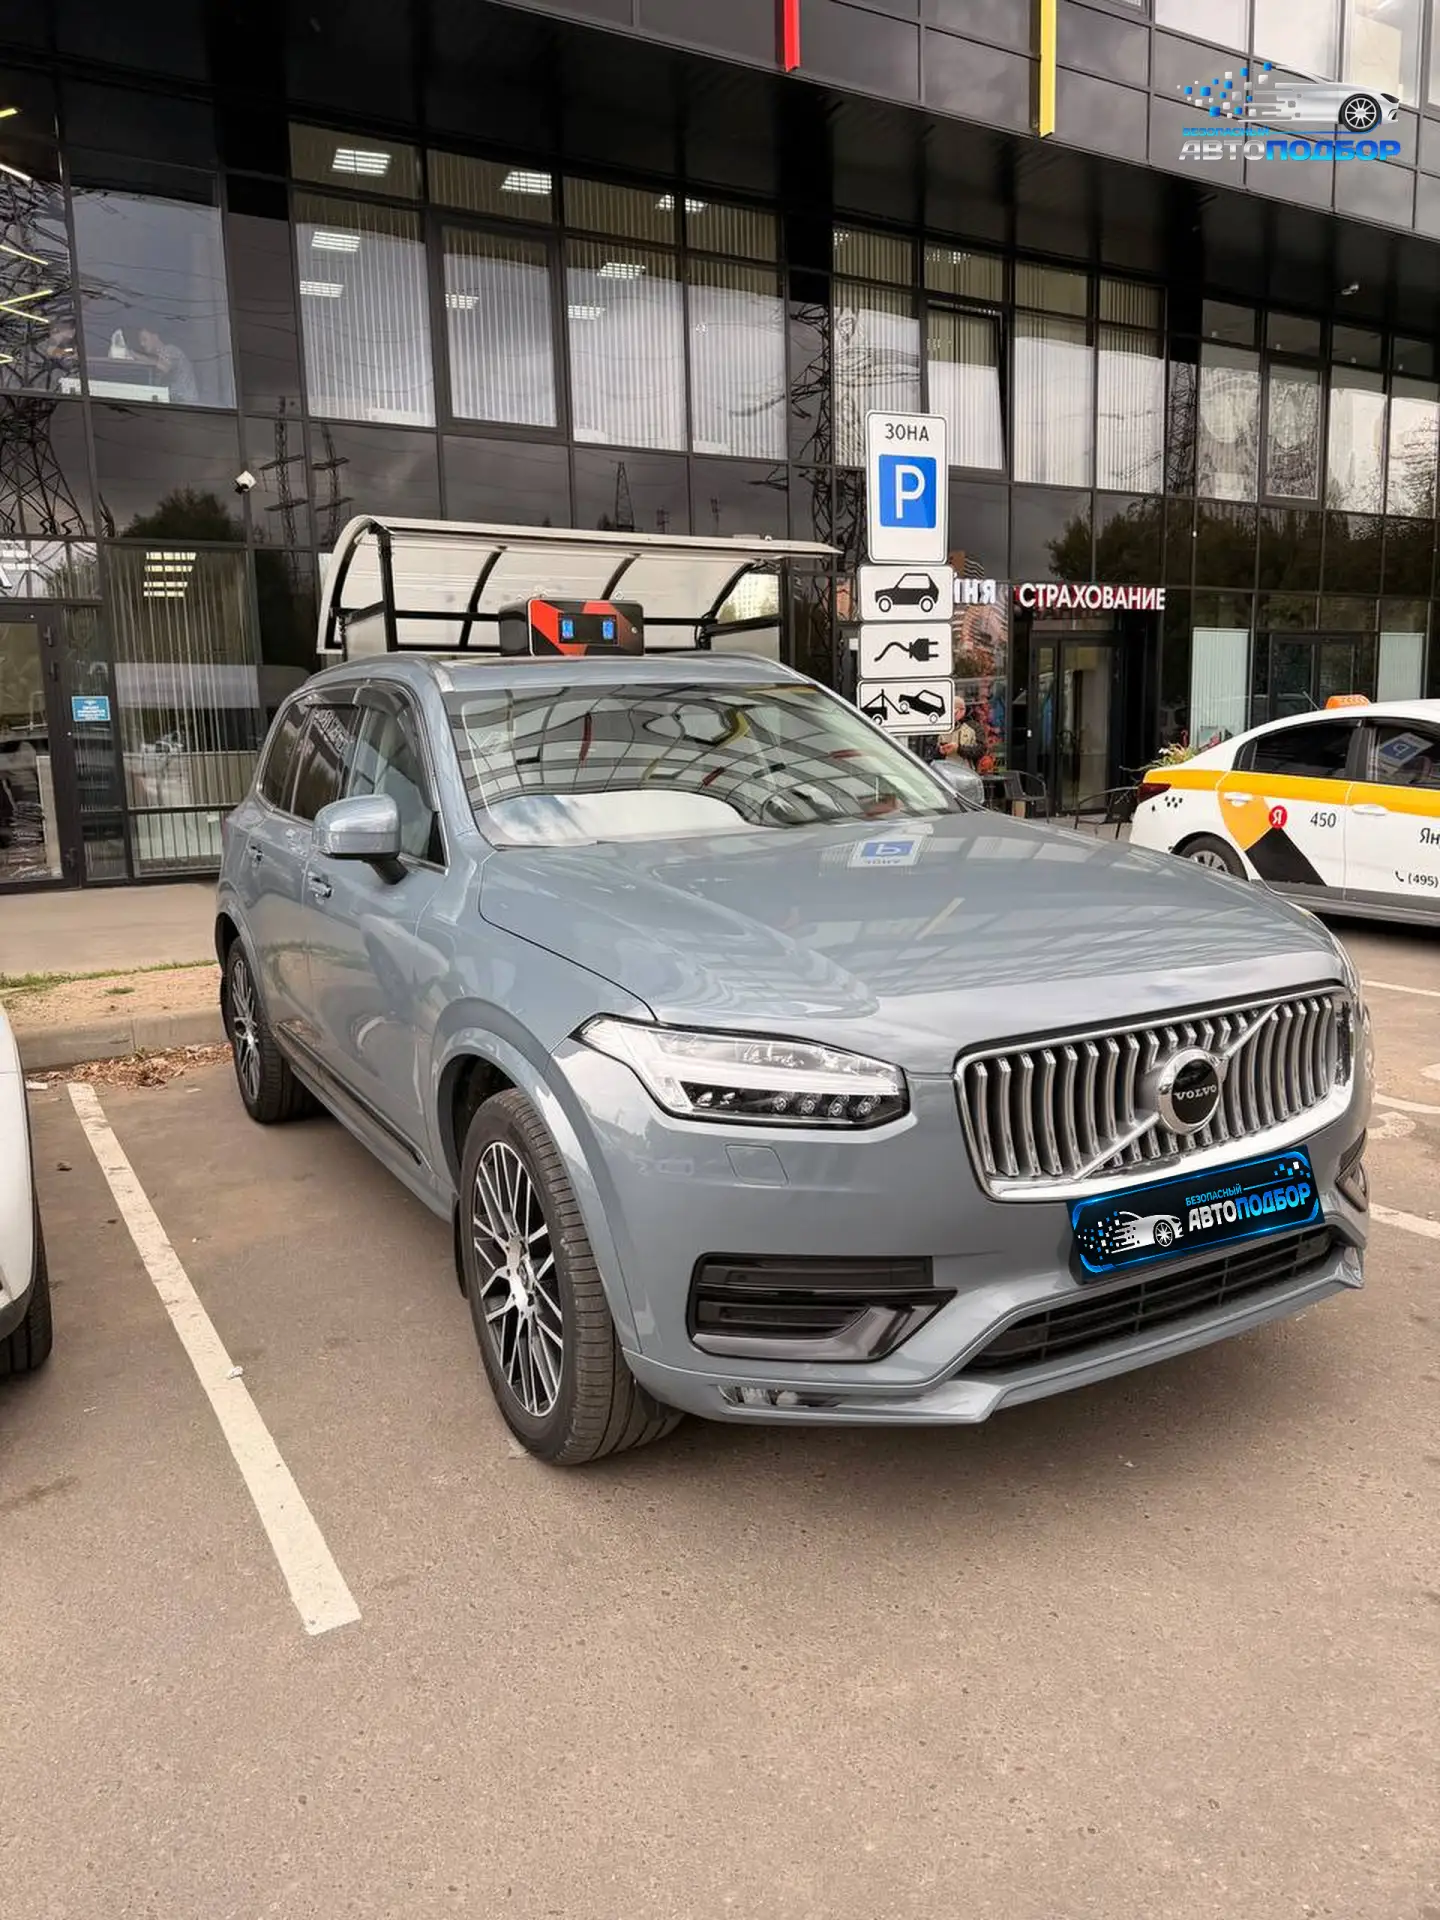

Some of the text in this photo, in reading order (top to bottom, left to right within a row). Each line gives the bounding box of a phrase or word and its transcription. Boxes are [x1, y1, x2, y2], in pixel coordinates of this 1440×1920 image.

[884, 422, 930, 442] ЗОНА
[894, 464, 926, 520] P
[1019, 582, 1166, 611] СТРАХОВАНИЕ
[1310, 811, 1336, 828] 450
[1408, 872, 1439, 889] (495)
[1173, 1084, 1218, 1101] VOLVO
